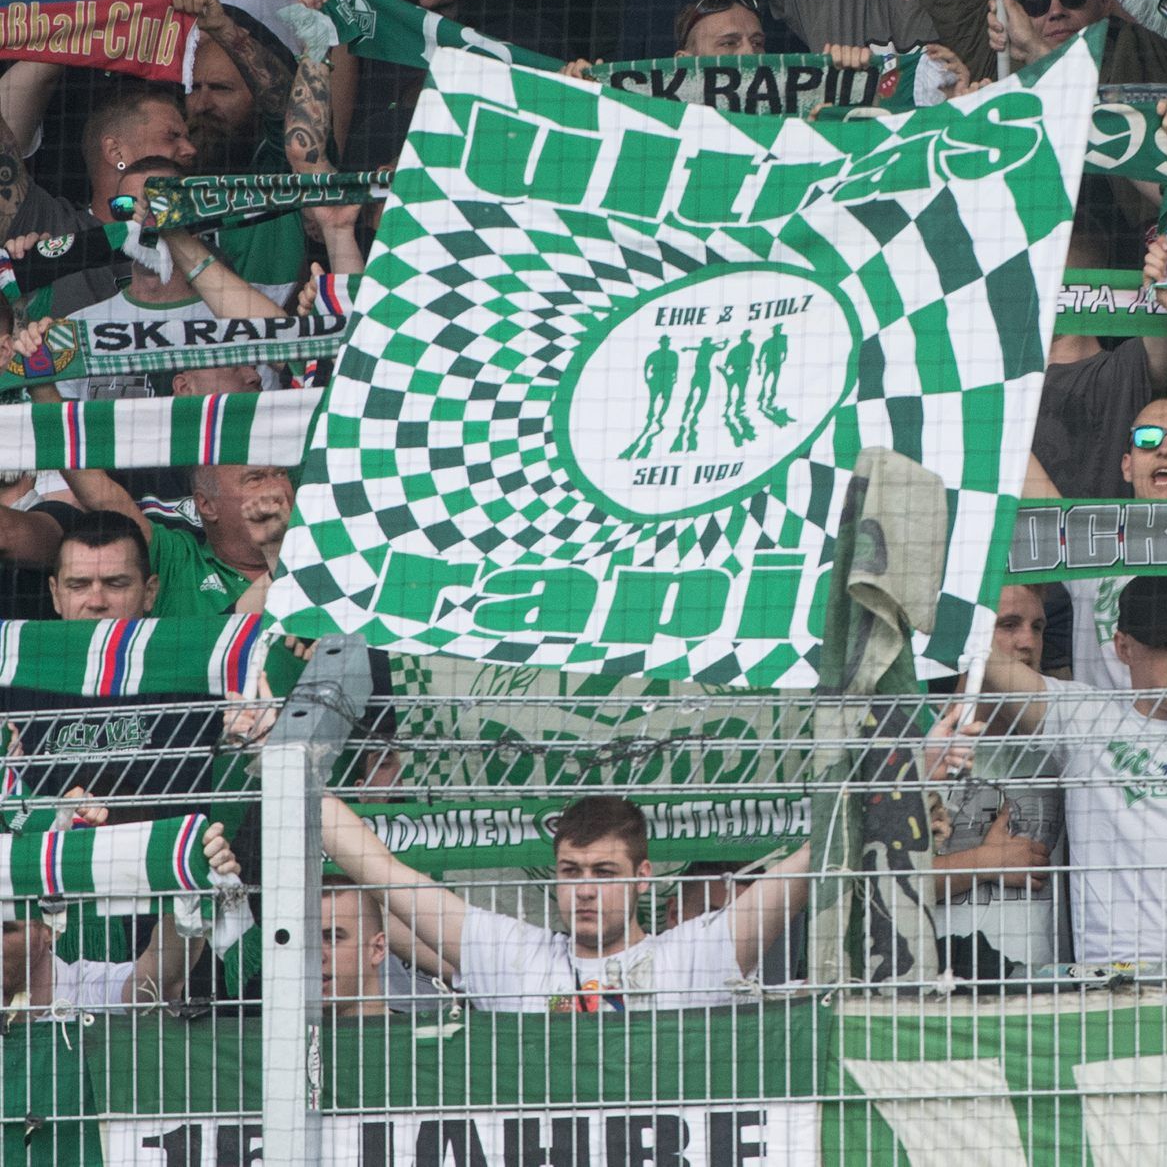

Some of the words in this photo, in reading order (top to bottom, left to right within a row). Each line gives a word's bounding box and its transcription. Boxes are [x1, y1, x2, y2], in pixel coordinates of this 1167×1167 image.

[702, 65, 881, 117] RAPID
[655, 305, 710, 327] EHRE
[748, 294, 815, 322] STOLZ
[93, 320, 174, 351] SK
[183, 313, 347, 347] RAPID
[632, 465, 682, 486] SEIT
[368, 544, 828, 643] rapi
[423, 807, 522, 849] WIEN
